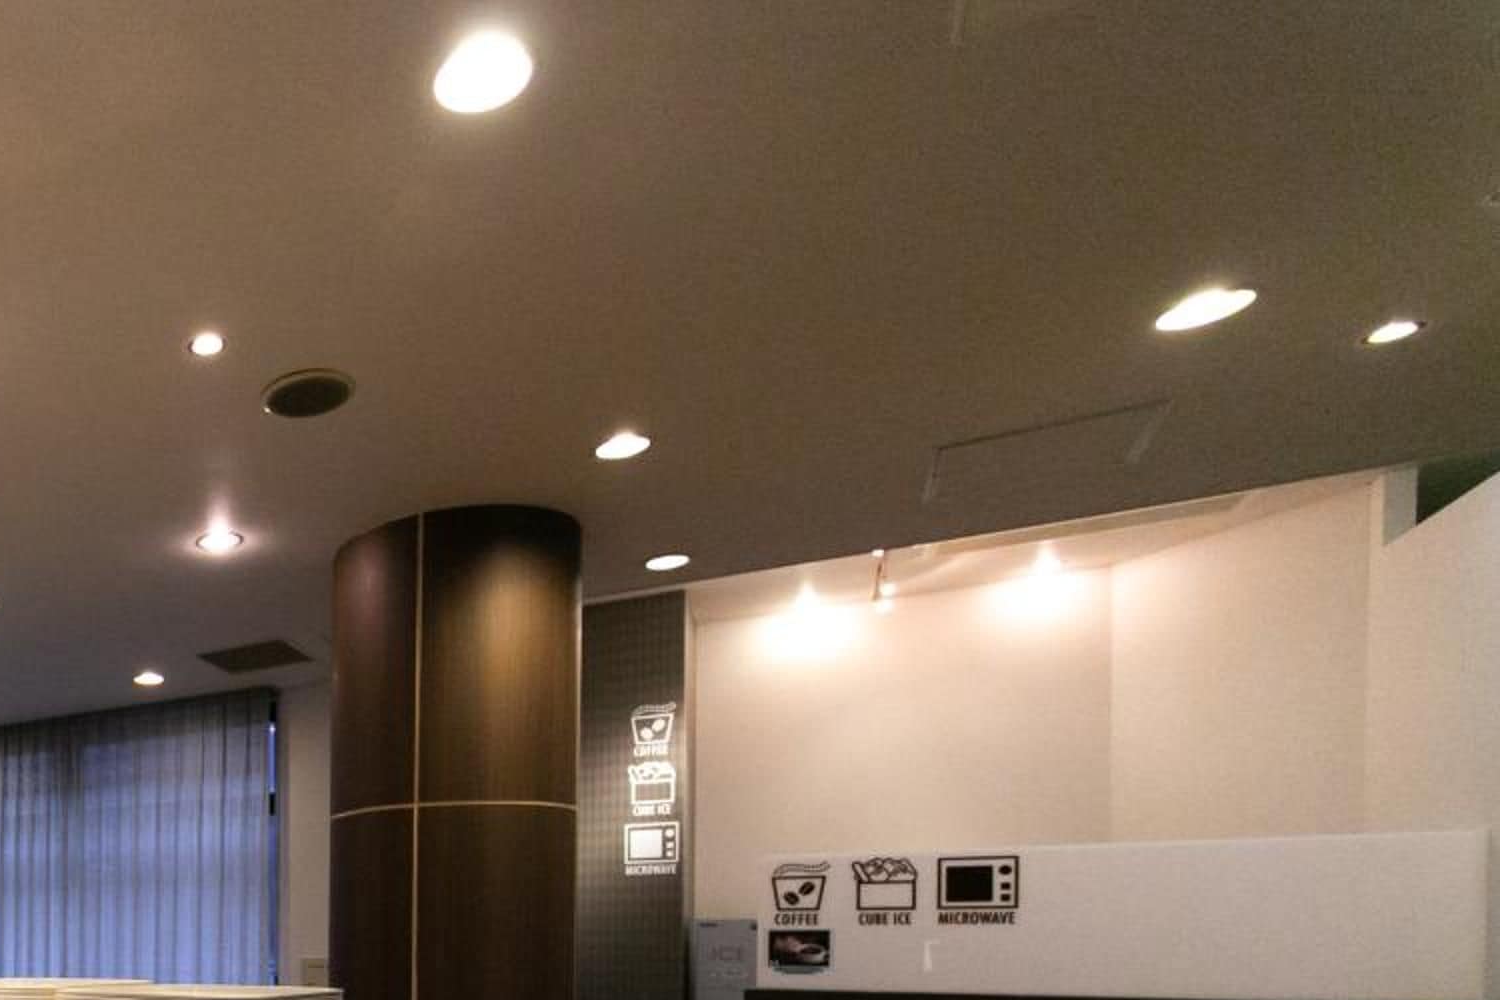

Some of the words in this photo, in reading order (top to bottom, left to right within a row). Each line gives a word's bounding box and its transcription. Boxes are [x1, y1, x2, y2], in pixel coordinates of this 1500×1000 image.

[773, 912, 820, 926] COFFEE
[857, 912, 888, 926] CUBE
[892, 912, 912, 926] ICE
[937, 911, 1016, 926] MICROWAVE
